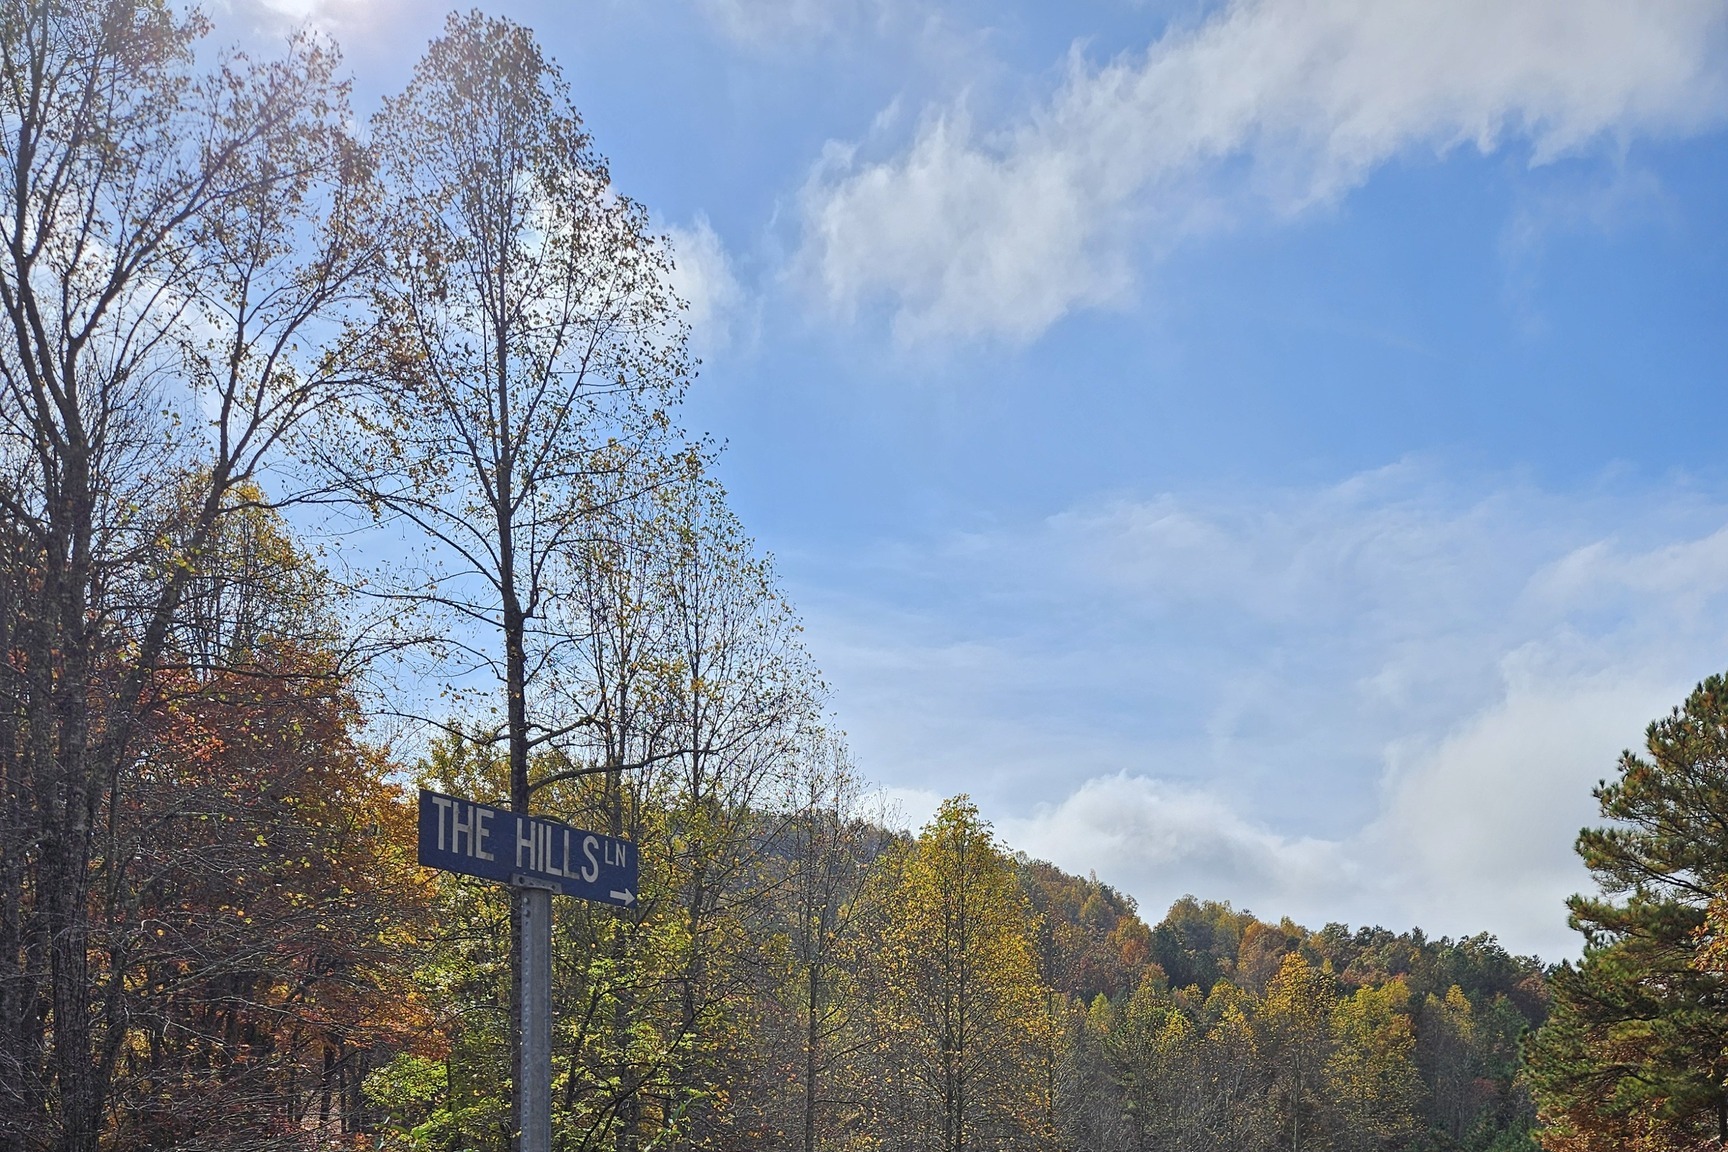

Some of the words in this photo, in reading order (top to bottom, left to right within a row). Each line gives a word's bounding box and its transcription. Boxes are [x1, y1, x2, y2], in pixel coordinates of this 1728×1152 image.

[432, 796, 494, 861] THE
[516, 817, 599, 883] HILLS
[604, 840, 626, 868] LN
